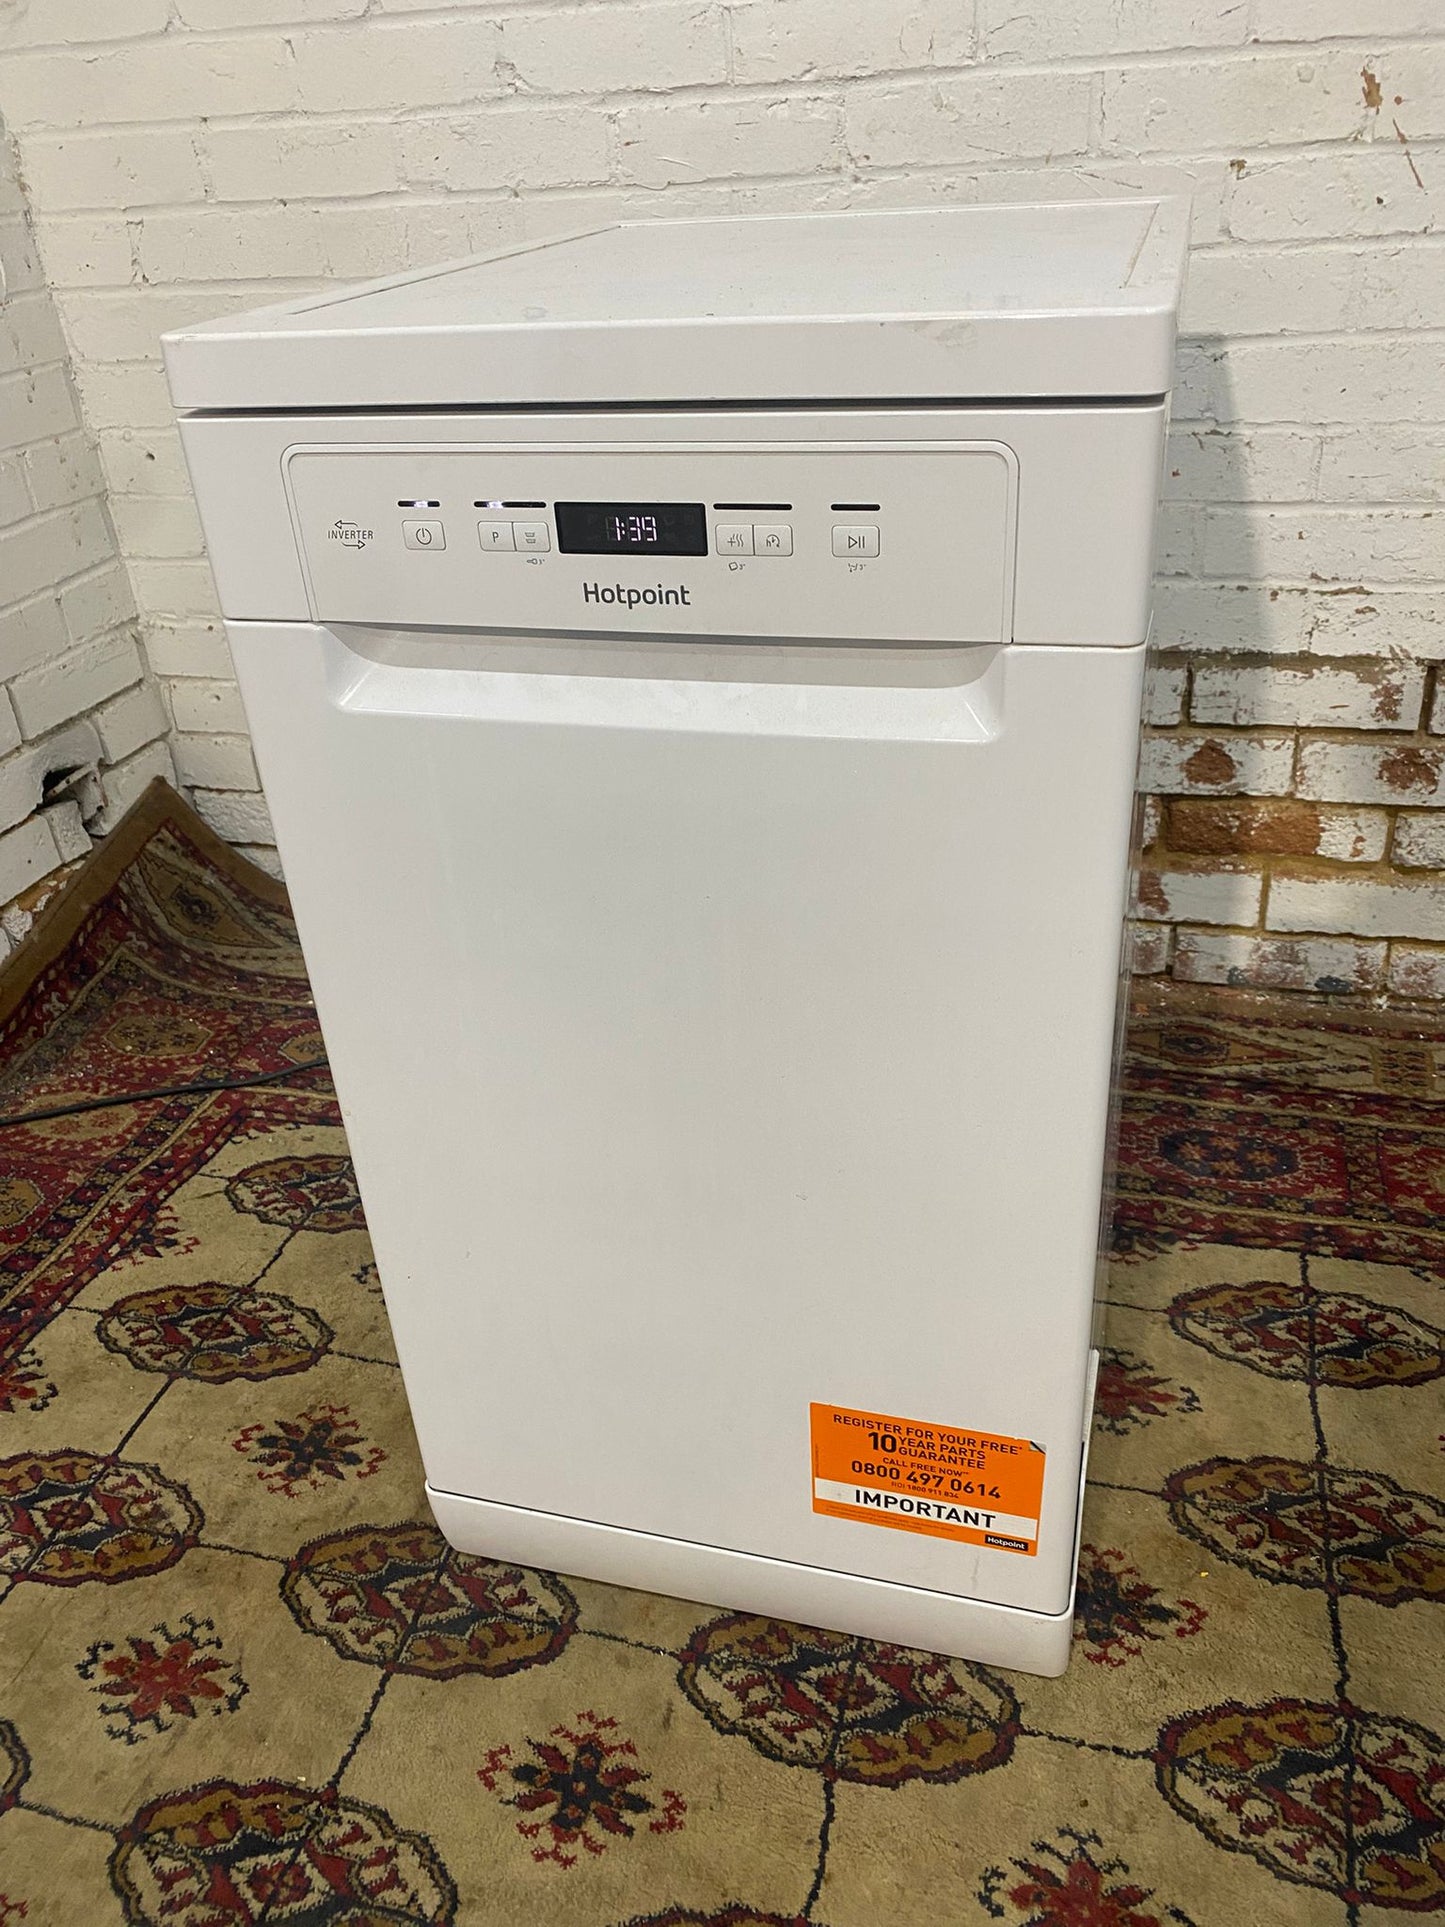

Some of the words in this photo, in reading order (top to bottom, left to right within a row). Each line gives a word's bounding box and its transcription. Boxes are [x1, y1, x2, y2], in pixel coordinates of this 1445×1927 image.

[327, 529, 374, 540] INVERTER
[491, 531, 500, 543] P
[615, 516, 657, 541] 1:39
[582, 582, 692, 610] Hotpoint
[833, 1414, 902, 1434] REGISTER
[906, 1427, 935, 1440] FOR
[938, 1432, 977, 1448] YOUR
[868, 1431, 897, 1453] 10
[898, 1436, 936, 1451] YEAR
[940, 1444, 986, 1460] PARTS
[882, 1457, 908, 1468] CALL
[910, 1462, 937, 1473] FREE
[898, 1446, 986, 1470] GUARANTEE
[851, 1460, 900, 1480] 0800
[906, 1471, 944, 1488] 497
[950, 1478, 1001, 1499] 0614
[907, 1484, 927, 1493] 1800
[855, 1489, 996, 1528] IMPORTANT
[987, 1536, 1026, 1550] Hotpoint
